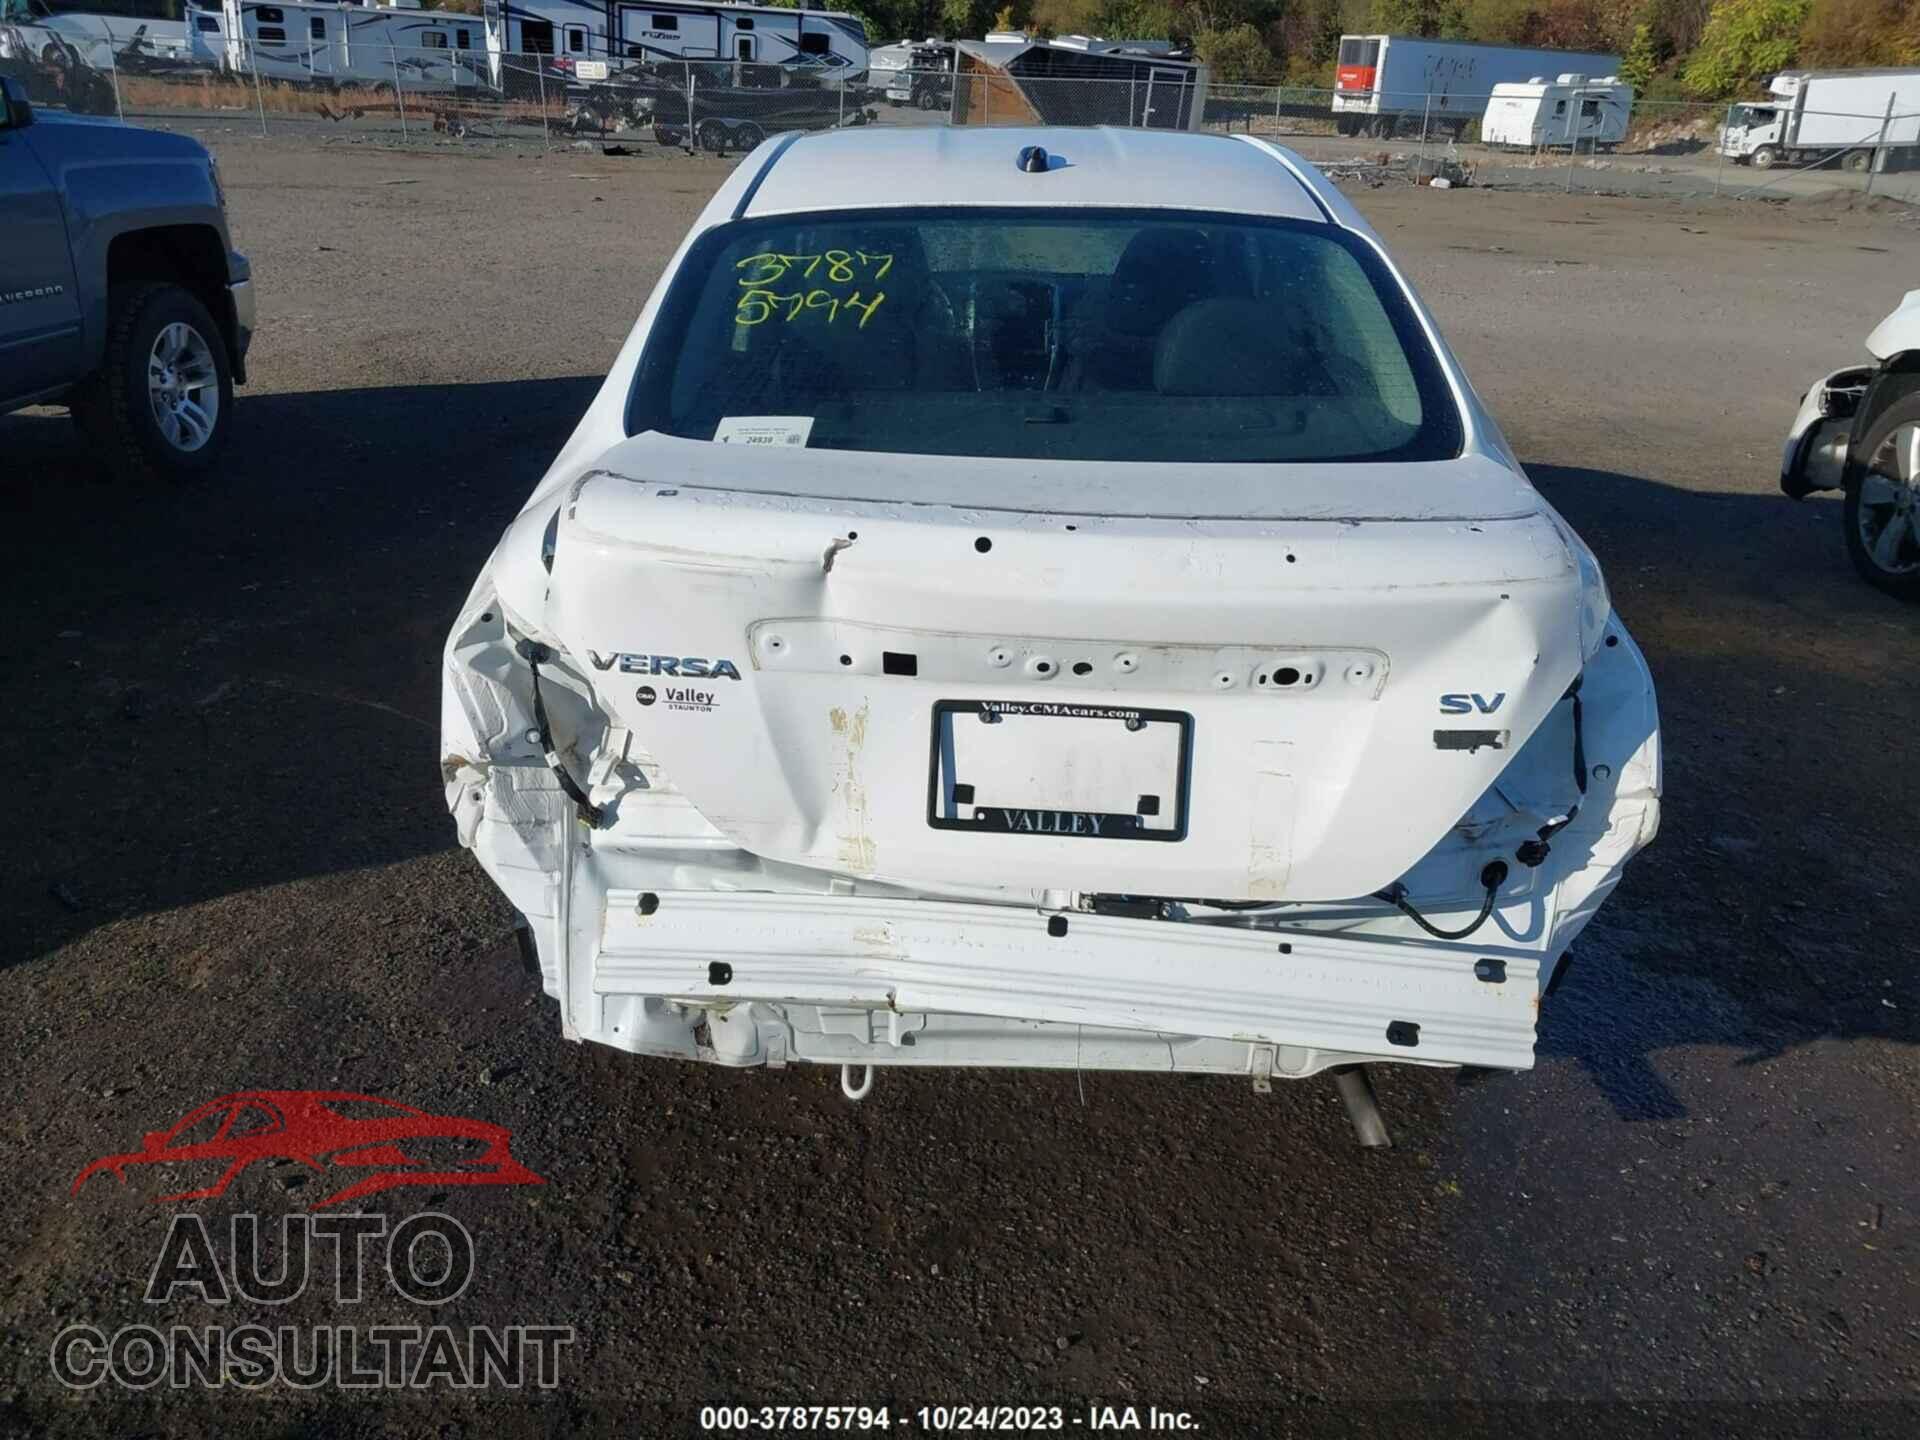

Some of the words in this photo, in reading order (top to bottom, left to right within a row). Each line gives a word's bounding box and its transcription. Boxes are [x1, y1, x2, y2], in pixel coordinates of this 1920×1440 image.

[736, 250, 894, 286] 3787
[735, 289, 885, 329] 5794
[586, 649, 742, 681] VERSA
[665, 687, 715, 705] Valley
[668, 703, 713, 713] STAUNTON
[1439, 692, 1506, 715] SV
[981, 701, 1140, 720] Valley.CMAcars.com
[1002, 809, 1107, 835] VALLEY
